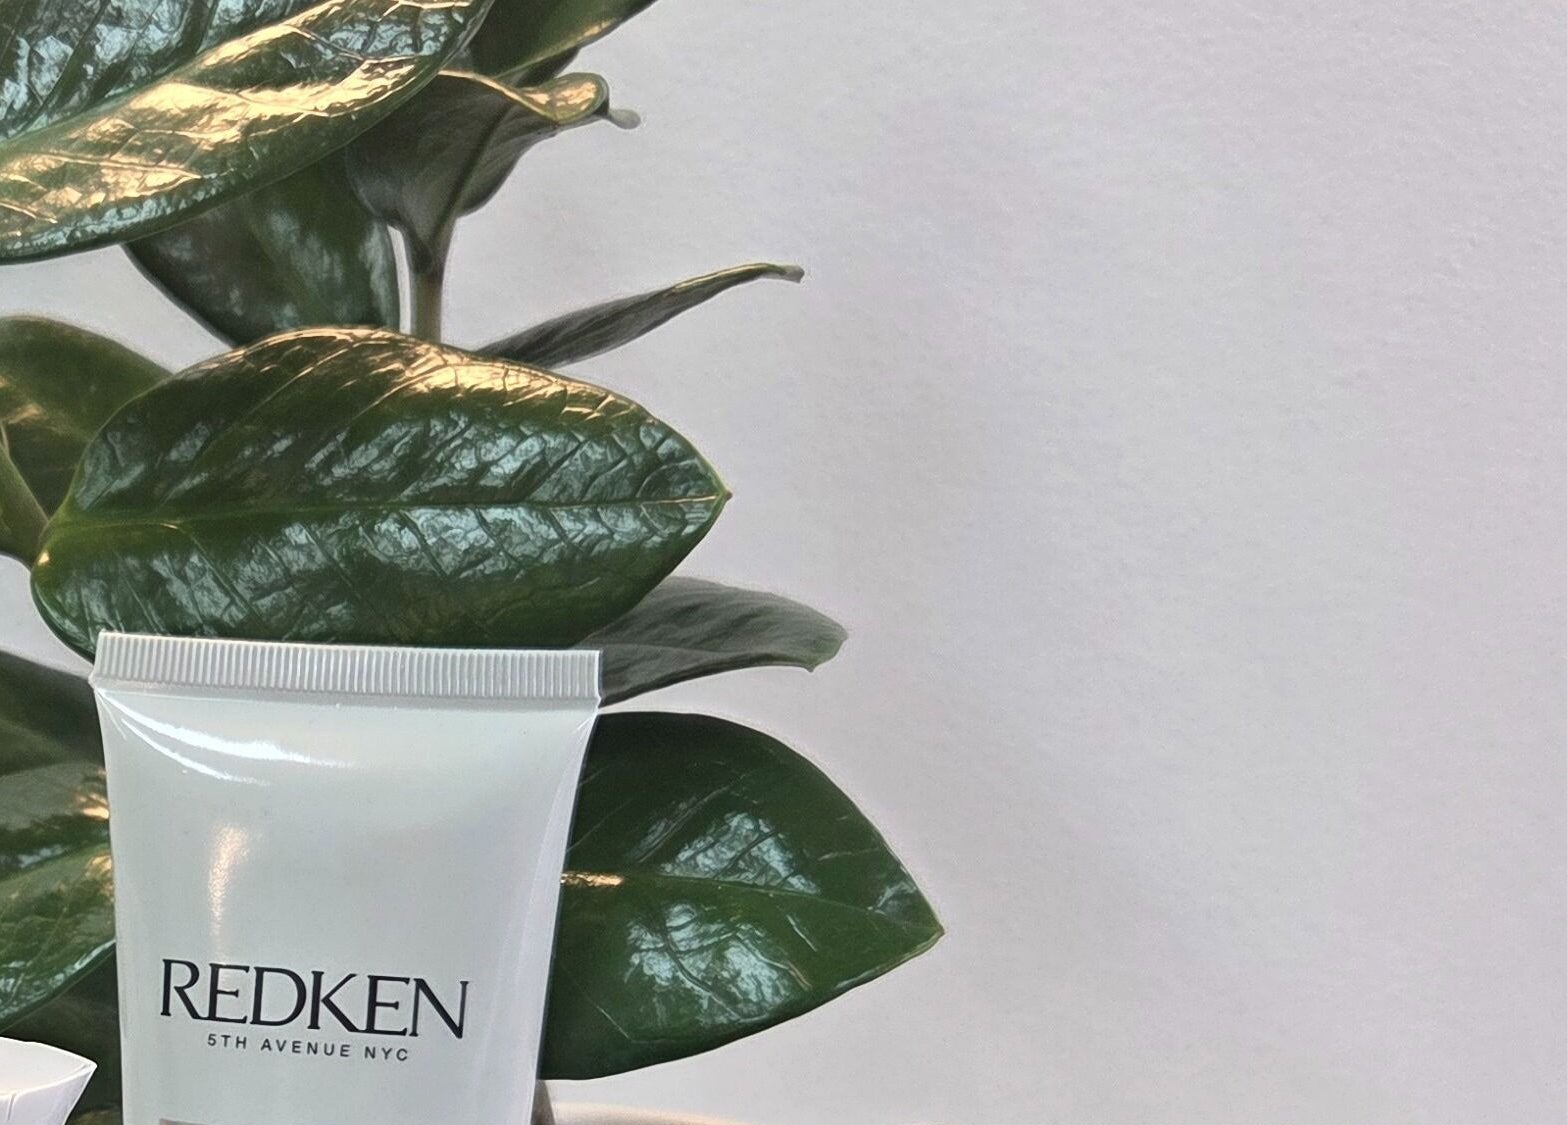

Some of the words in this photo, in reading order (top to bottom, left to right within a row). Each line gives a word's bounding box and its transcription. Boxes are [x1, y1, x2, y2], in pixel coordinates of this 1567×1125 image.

[160, 959, 469, 1039] REDKEN
[207, 1034, 247, 1050] 5TH
[261, 1039, 350, 1058] AVENUE
[364, 1047, 408, 1061] NYC
